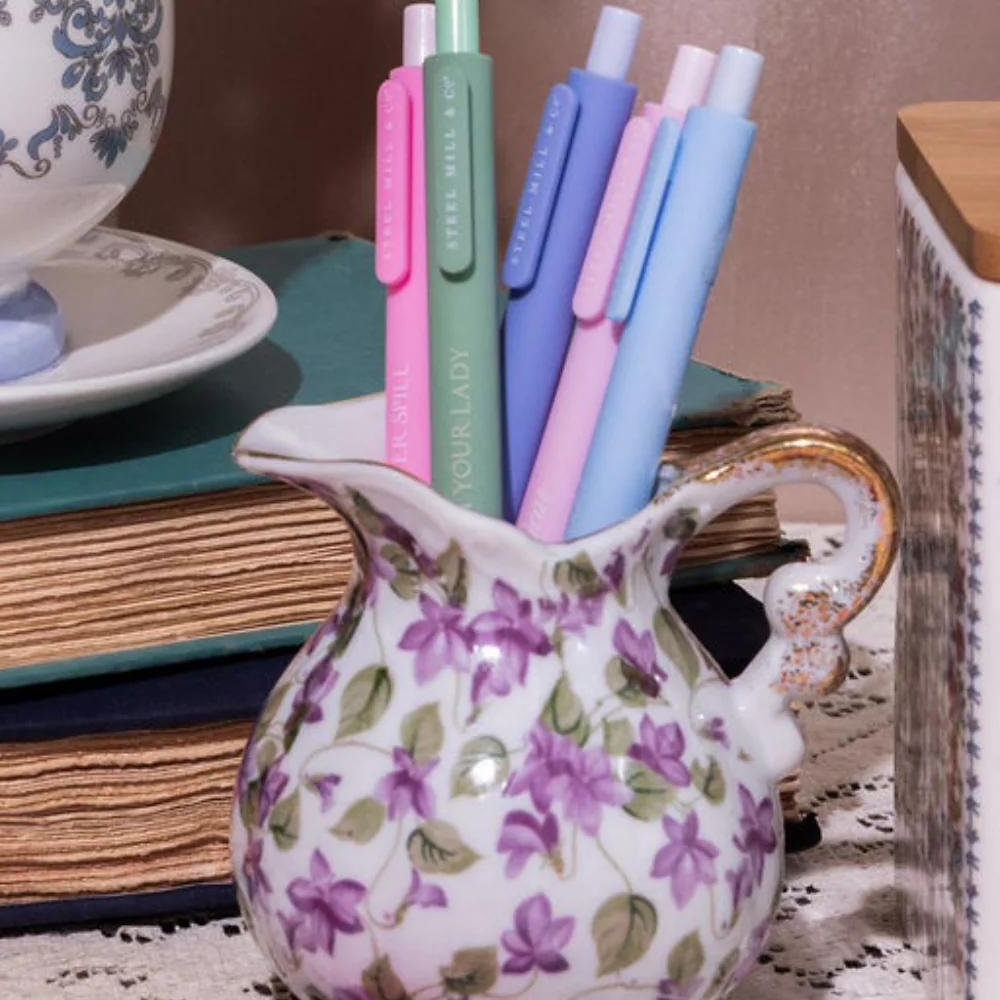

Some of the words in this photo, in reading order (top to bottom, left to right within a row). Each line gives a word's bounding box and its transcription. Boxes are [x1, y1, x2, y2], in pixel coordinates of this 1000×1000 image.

[444, 128, 457, 177] MILL
[528, 146, 549, 196] MILL
[444, 188, 459, 250] STEEL
[391, 362, 409, 424] SPILL
[449, 347, 471, 416] LADY
[450, 421, 473, 497] YOUR
